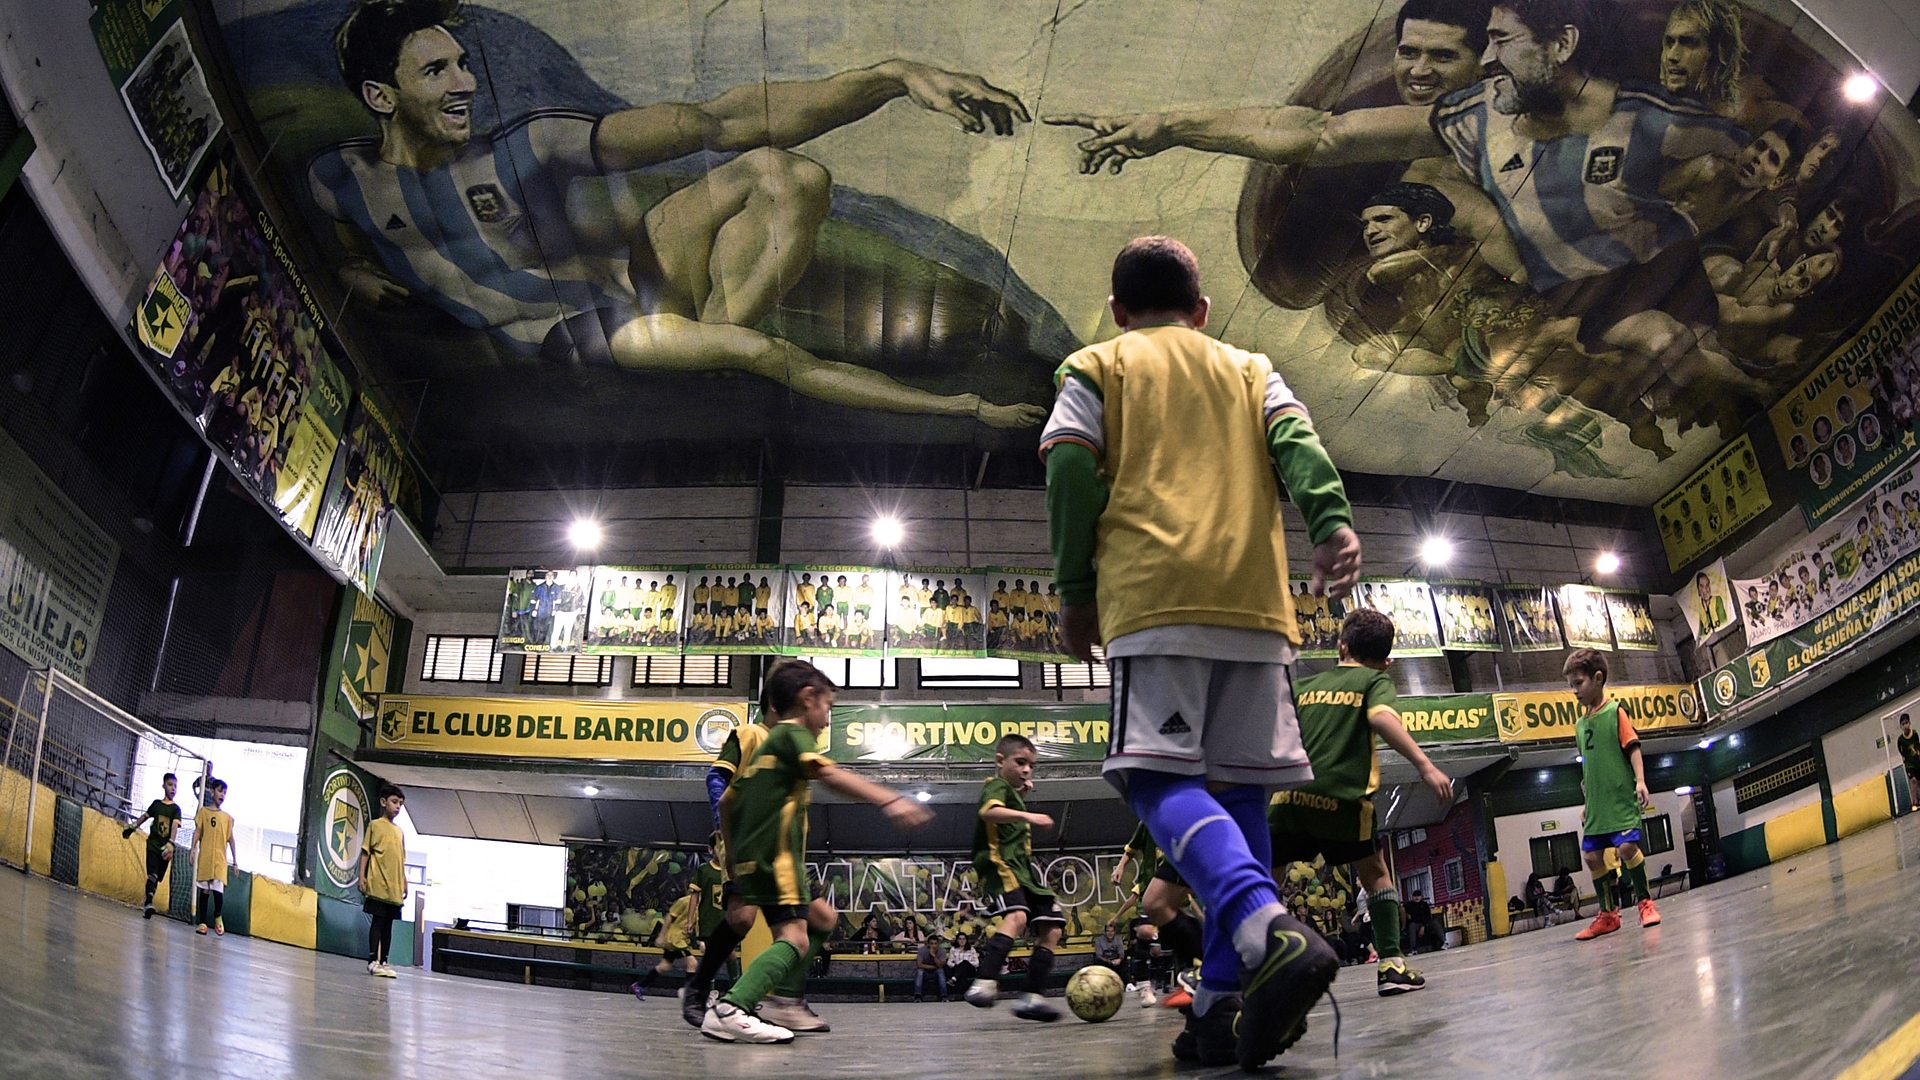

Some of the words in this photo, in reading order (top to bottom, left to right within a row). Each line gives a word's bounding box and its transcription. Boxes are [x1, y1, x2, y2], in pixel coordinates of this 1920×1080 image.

[257, 210, 274, 241] Club
[272, 240, 301, 289] Sportivo
[299, 285, 326, 331] Pereyra
[156, 275, 190, 328] BARRACAS
[1804, 372, 1828, 401] UN
[1825, 324, 1882, 383] EQUIPO
[320, 379, 342, 416] 2007
[1716, 440, 1745, 466] AMISTAD
[1862, 461, 1885, 483] OFICIAL
[1880, 470, 1914, 495] TIGRES
[1718, 512, 1755, 540] CATEGORIA
[804, 564, 858, 573] CATEGORIA
[1835, 595, 1859, 623] QUE
[1857, 570, 1898, 607] SUEÑA
[1787, 655, 1801, 672] EL
[1800, 640, 1825, 666] QUE
[1824, 618, 1864, 658] SUEÑA
[1862, 603, 1889, 630] CON
[31, 633, 46, 651] LOS
[46, 643, 83, 675] NUESTROS
[412, 710, 440, 735] EL
[444, 712, 512, 738] CLUB
[516, 714, 568, 740] DEL
[573, 716, 689, 743] BARRIO
[1401, 707, 1487, 732] RRACAS"
[1524, 698, 1590, 729] SOMO
[1613, 693, 1677, 721] NICOS
[846, 720, 997, 746] SPORTIVO
[1001, 720, 1110, 745] PEREYR
[1584, 728, 1595, 750] 2
[323, 776, 350, 805] SPORTIVO
[210, 816, 217, 828] 6
[806, 853, 1145, 913] MATAOR
